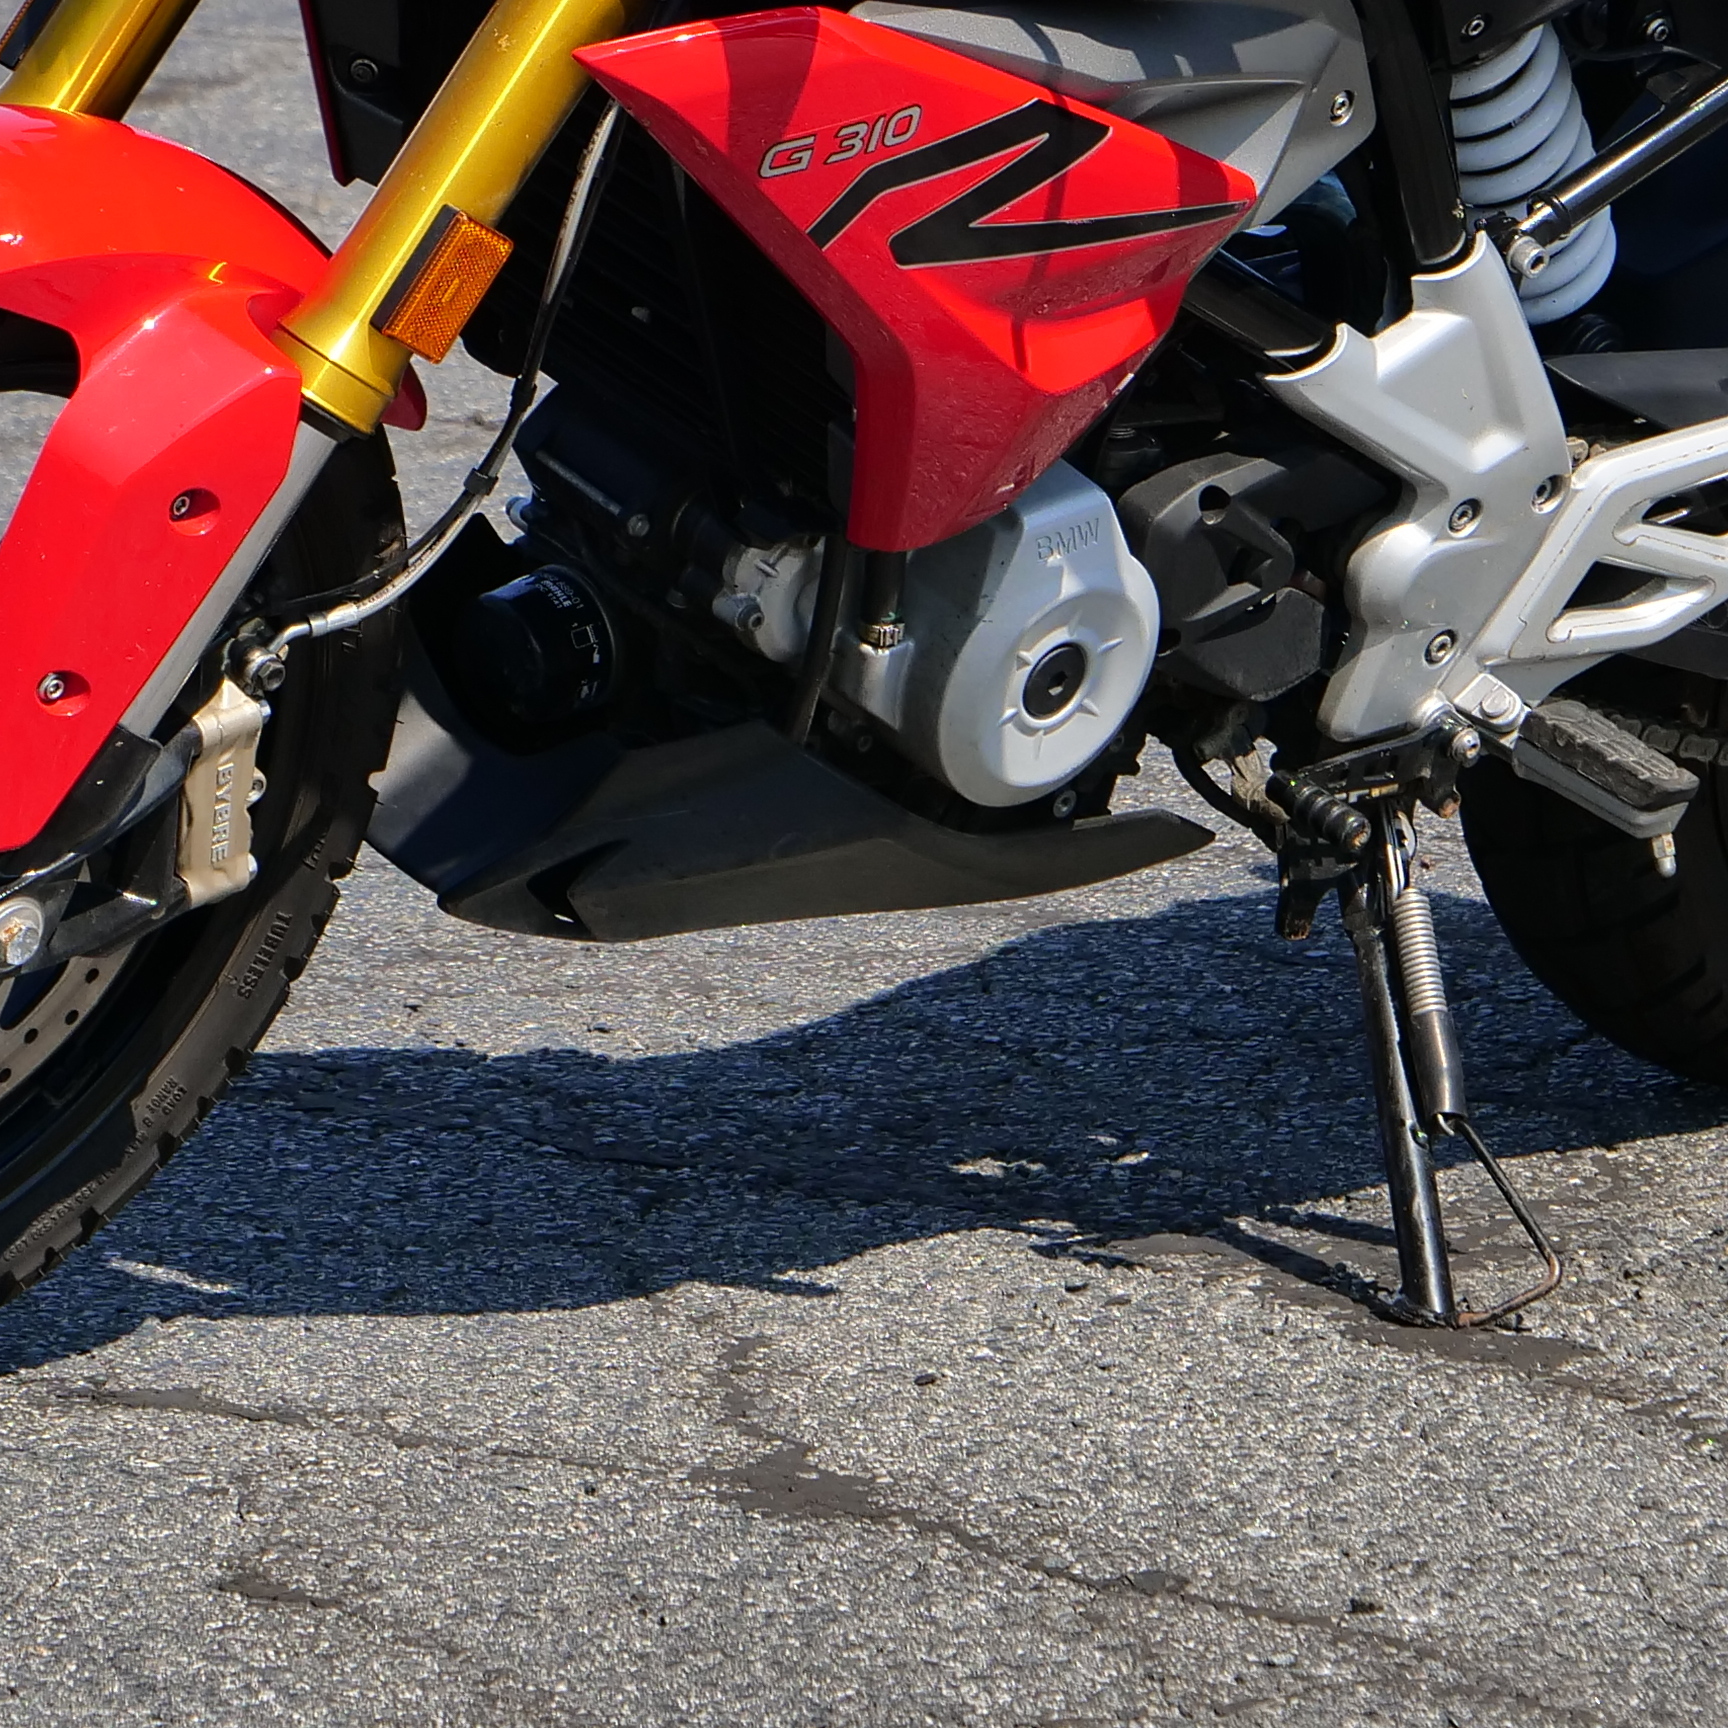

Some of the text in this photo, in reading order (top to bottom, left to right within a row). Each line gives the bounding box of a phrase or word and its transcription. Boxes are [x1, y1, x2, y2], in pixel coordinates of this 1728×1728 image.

[757, 104, 922, 180] G 310
[1034, 517, 1102, 565] BMW
[210, 762, 233, 864] BYBRE
[240, 910, 292, 1002] TUBELESS
